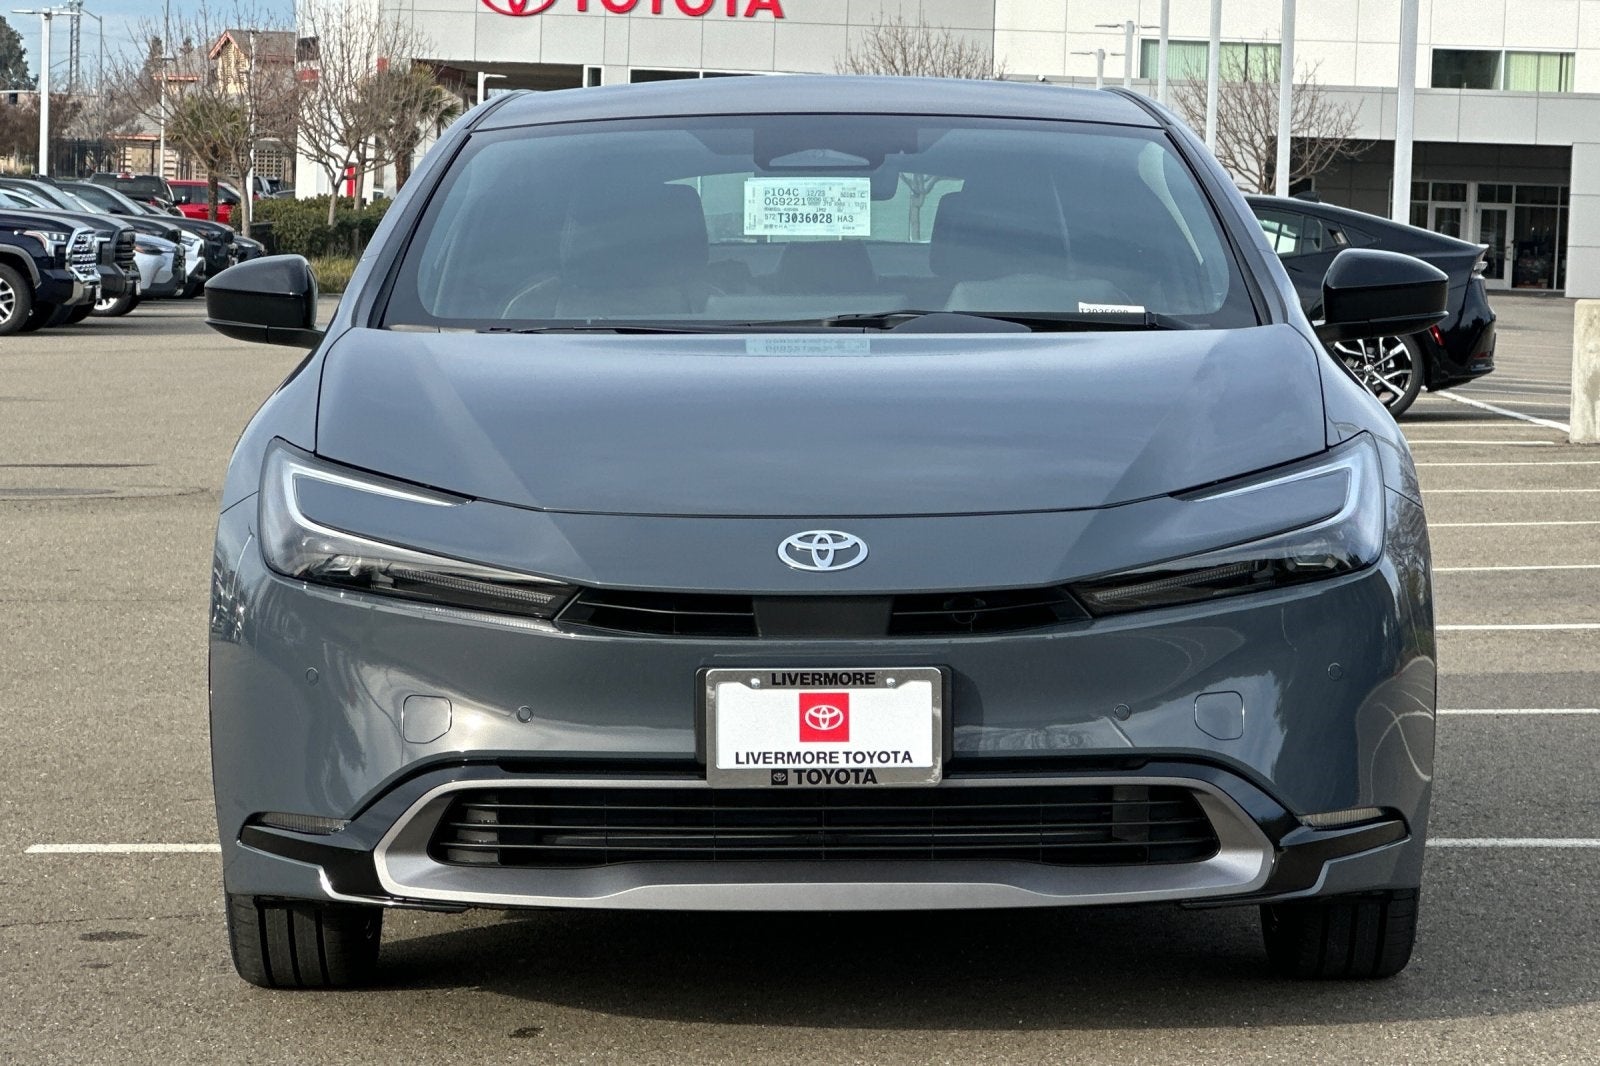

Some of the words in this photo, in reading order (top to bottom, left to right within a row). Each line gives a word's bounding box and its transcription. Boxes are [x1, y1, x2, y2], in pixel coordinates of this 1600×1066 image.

[778, 212, 833, 223] T3036028
[771, 672, 876, 686] LIVERMORE
[735, 751, 839, 765] LIVERMORE
[842, 750, 913, 764] TOYOTA
[793, 768, 878, 785] TOYOTA
